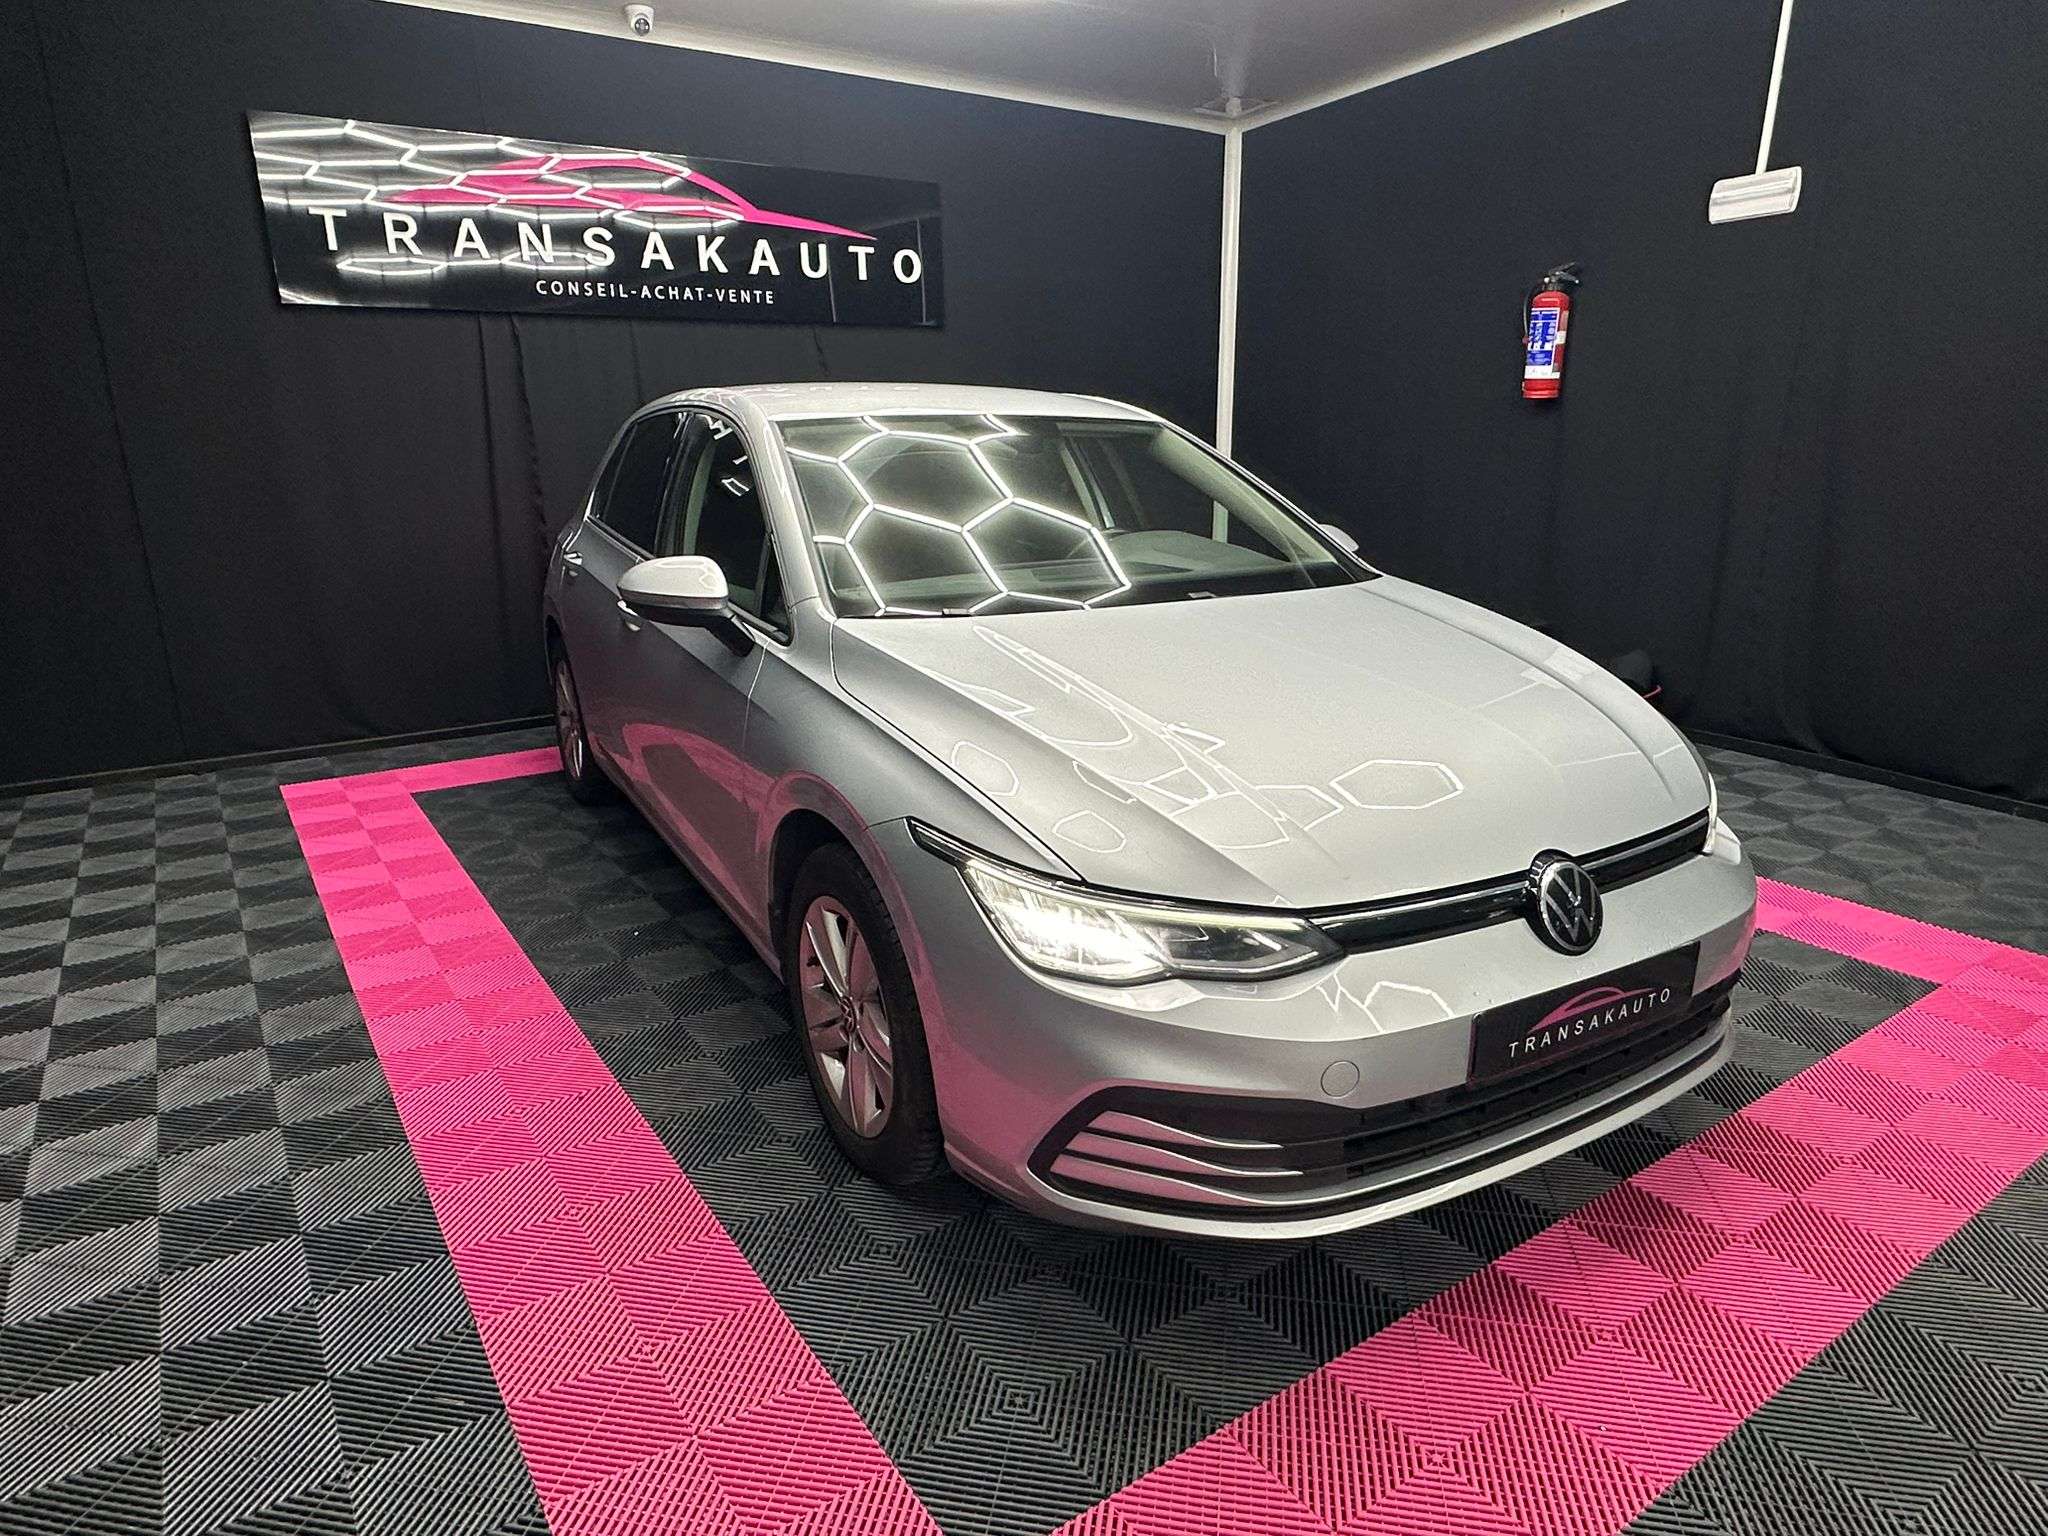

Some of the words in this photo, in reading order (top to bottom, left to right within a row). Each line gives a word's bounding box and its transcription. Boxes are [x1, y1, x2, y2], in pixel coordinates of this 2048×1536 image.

[308, 207, 922, 283] TRANSAKAUTO
[535, 279, 774, 304] CONSEIL-ACHAT-VENTE
[1509, 988, 1670, 1058] TRANSAKAUTO
